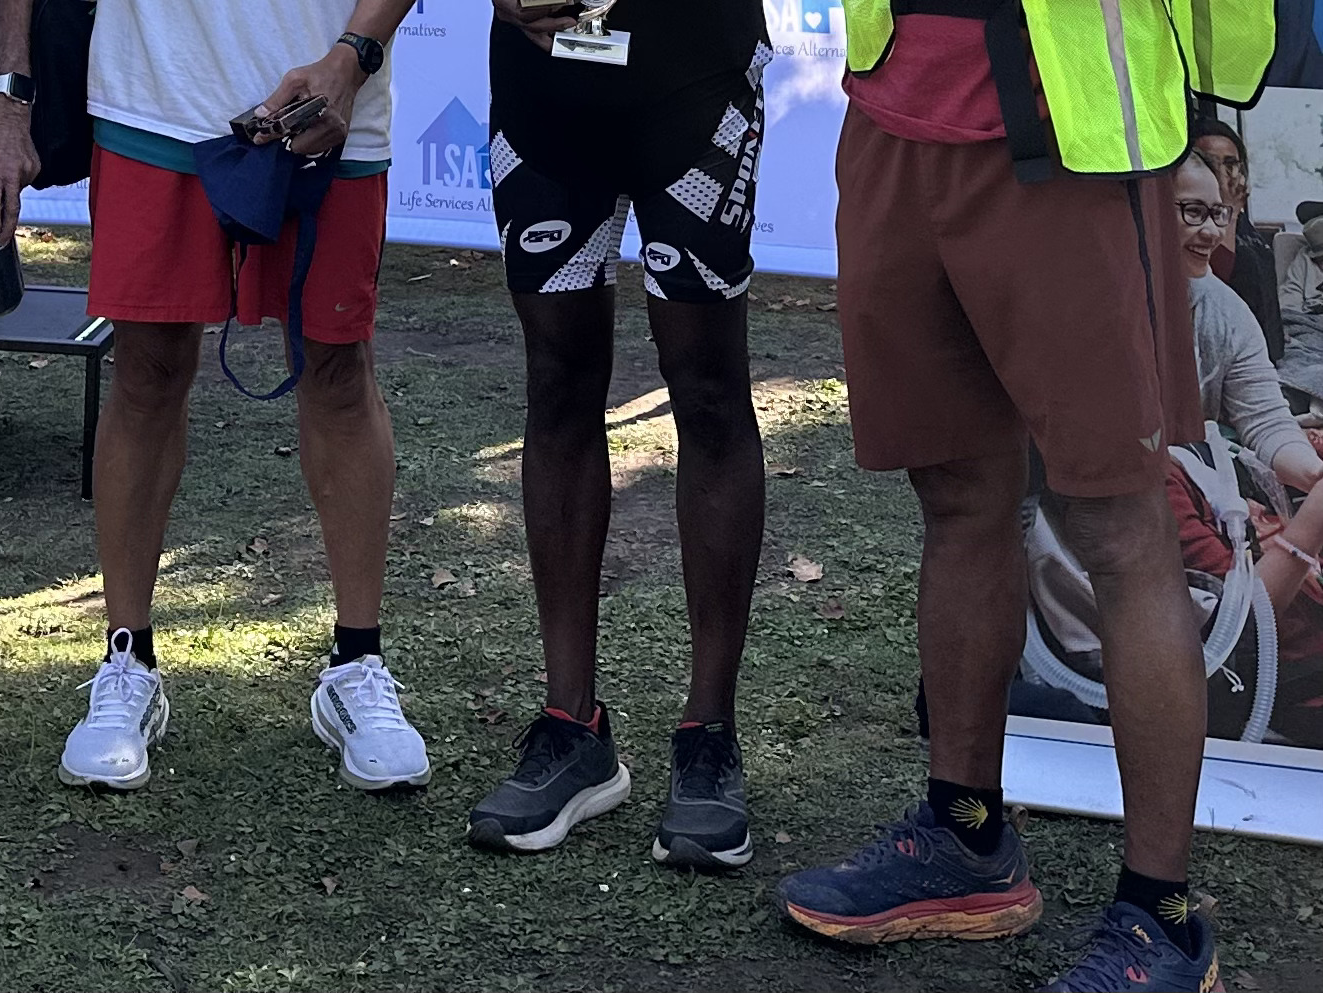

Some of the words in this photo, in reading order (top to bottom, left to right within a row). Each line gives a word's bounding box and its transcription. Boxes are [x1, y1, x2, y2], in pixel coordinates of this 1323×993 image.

[398, 23, 447, 37] rnatives
[797, 41, 847, 58] Alterna
[429, 142, 482, 189] LSA
[399, 191, 422, 211] Life
[425, 193, 473, 211] Services
